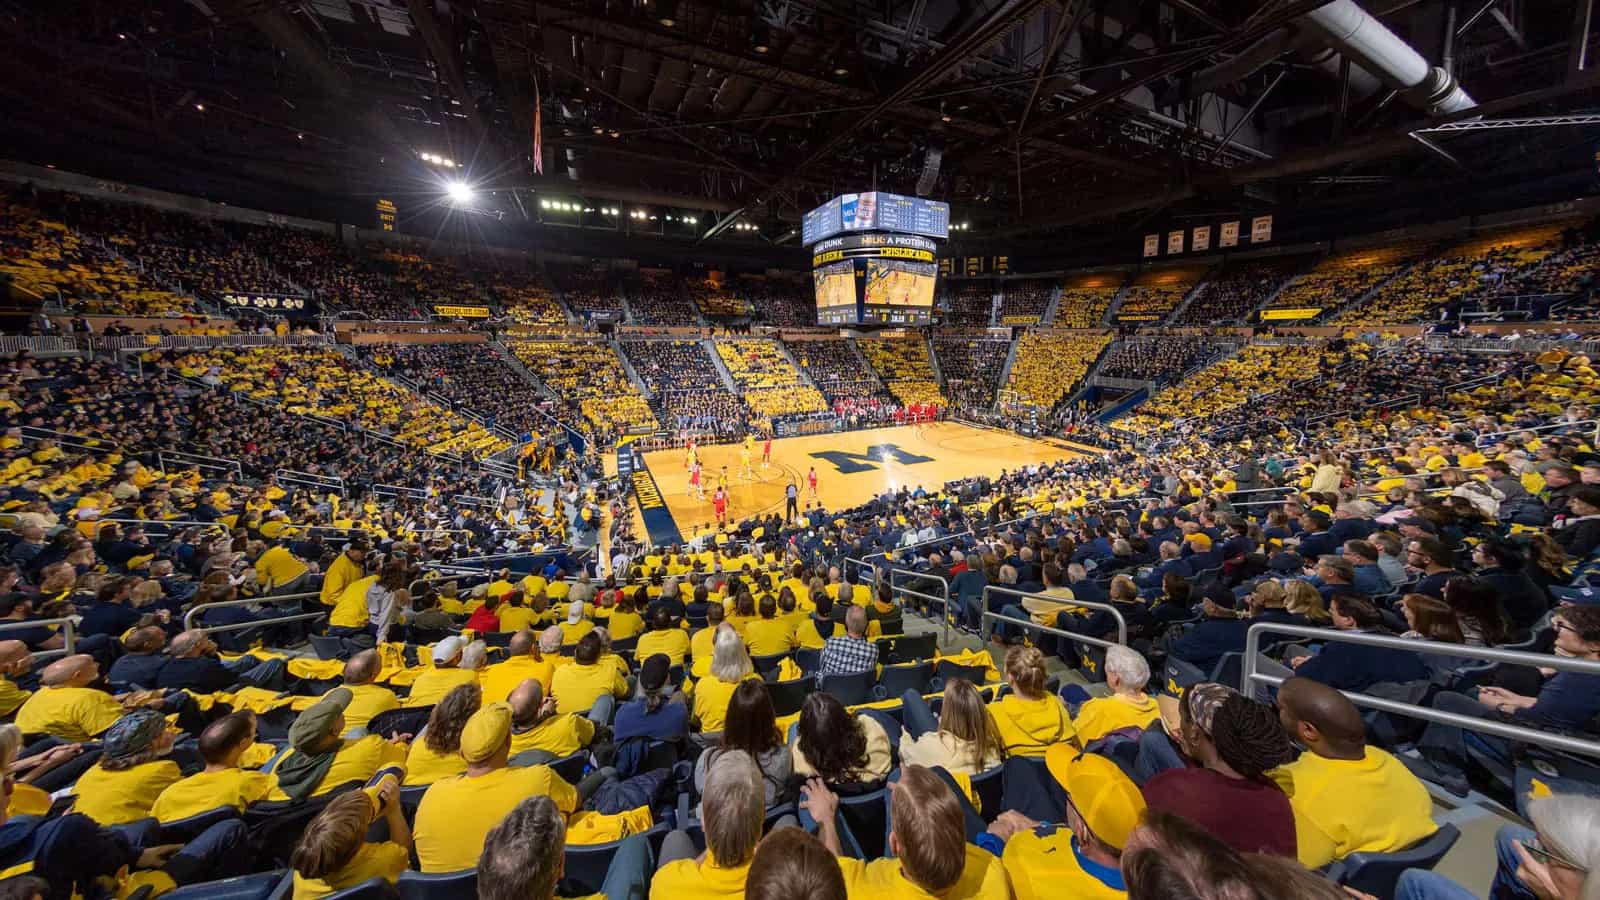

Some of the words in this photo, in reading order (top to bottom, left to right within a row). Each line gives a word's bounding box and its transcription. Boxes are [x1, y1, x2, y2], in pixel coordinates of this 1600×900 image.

[824, 238, 843, 249] DUNK
[895, 238, 925, 247] PROTEIN
[808, 443, 935, 474] M
[632, 470, 664, 510] MICHIGAN
